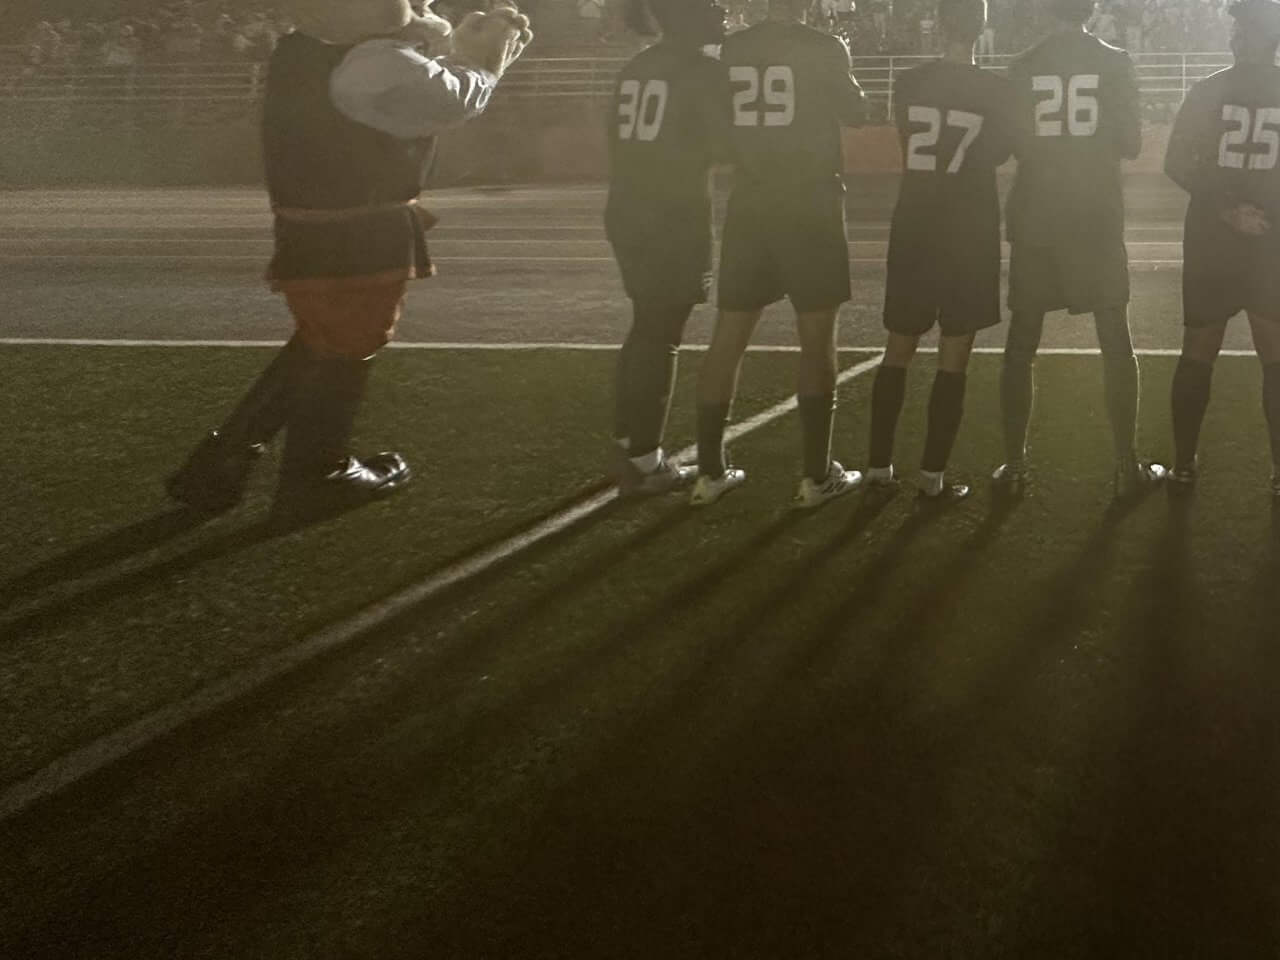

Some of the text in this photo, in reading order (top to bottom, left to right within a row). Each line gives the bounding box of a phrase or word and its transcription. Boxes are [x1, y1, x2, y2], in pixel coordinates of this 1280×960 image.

[618, 80, 668, 140] 30
[729, 66, 795, 126] 29
[1031, 75, 1099, 136] 26
[907, 106, 984, 173] 27
